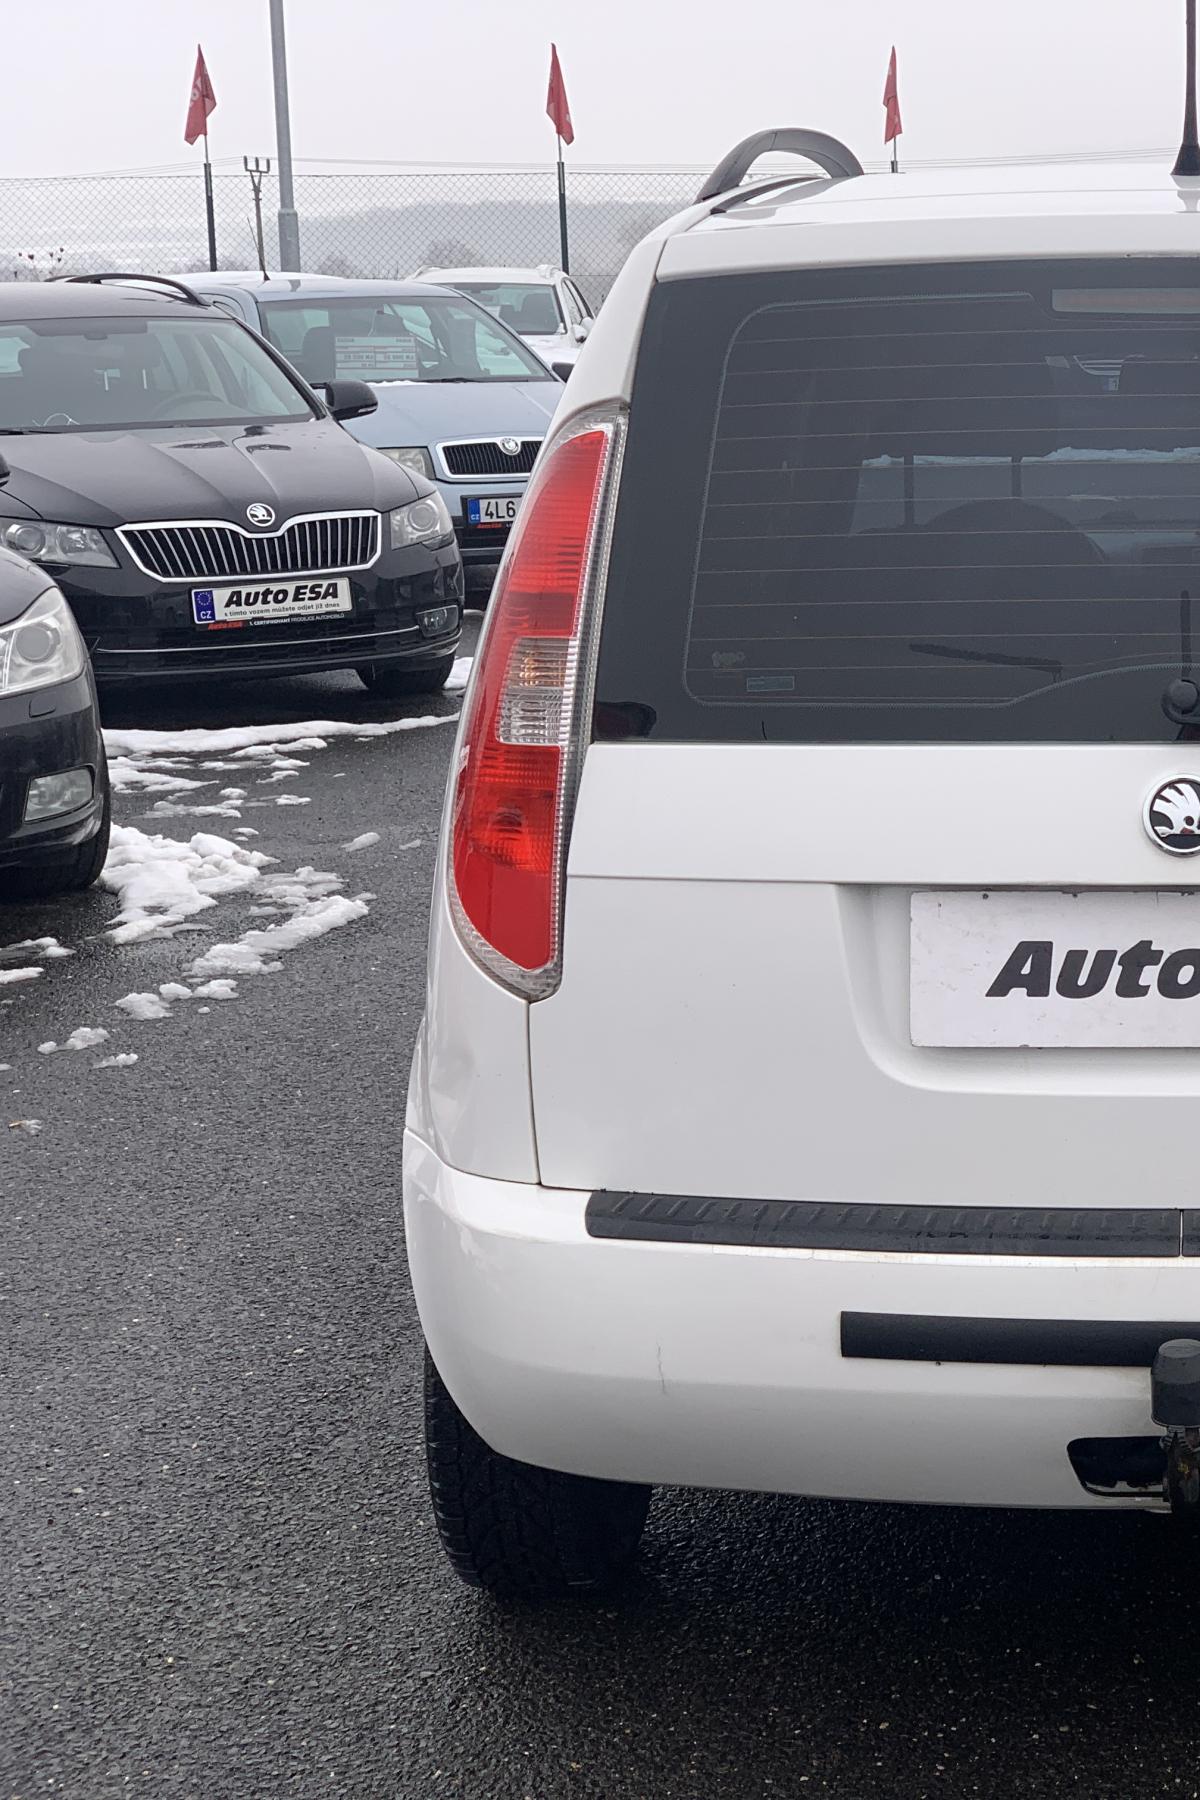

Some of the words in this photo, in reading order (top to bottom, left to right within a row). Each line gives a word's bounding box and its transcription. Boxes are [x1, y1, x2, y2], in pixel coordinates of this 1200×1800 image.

[485, 501, 516, 519] 4L6
[224, 587, 289, 609] Auto
[292, 582, 339, 603] ESA
[200, 610, 212, 619] CZ
[249, 608, 271, 616] vozem
[297, 603, 314, 611] odjet
